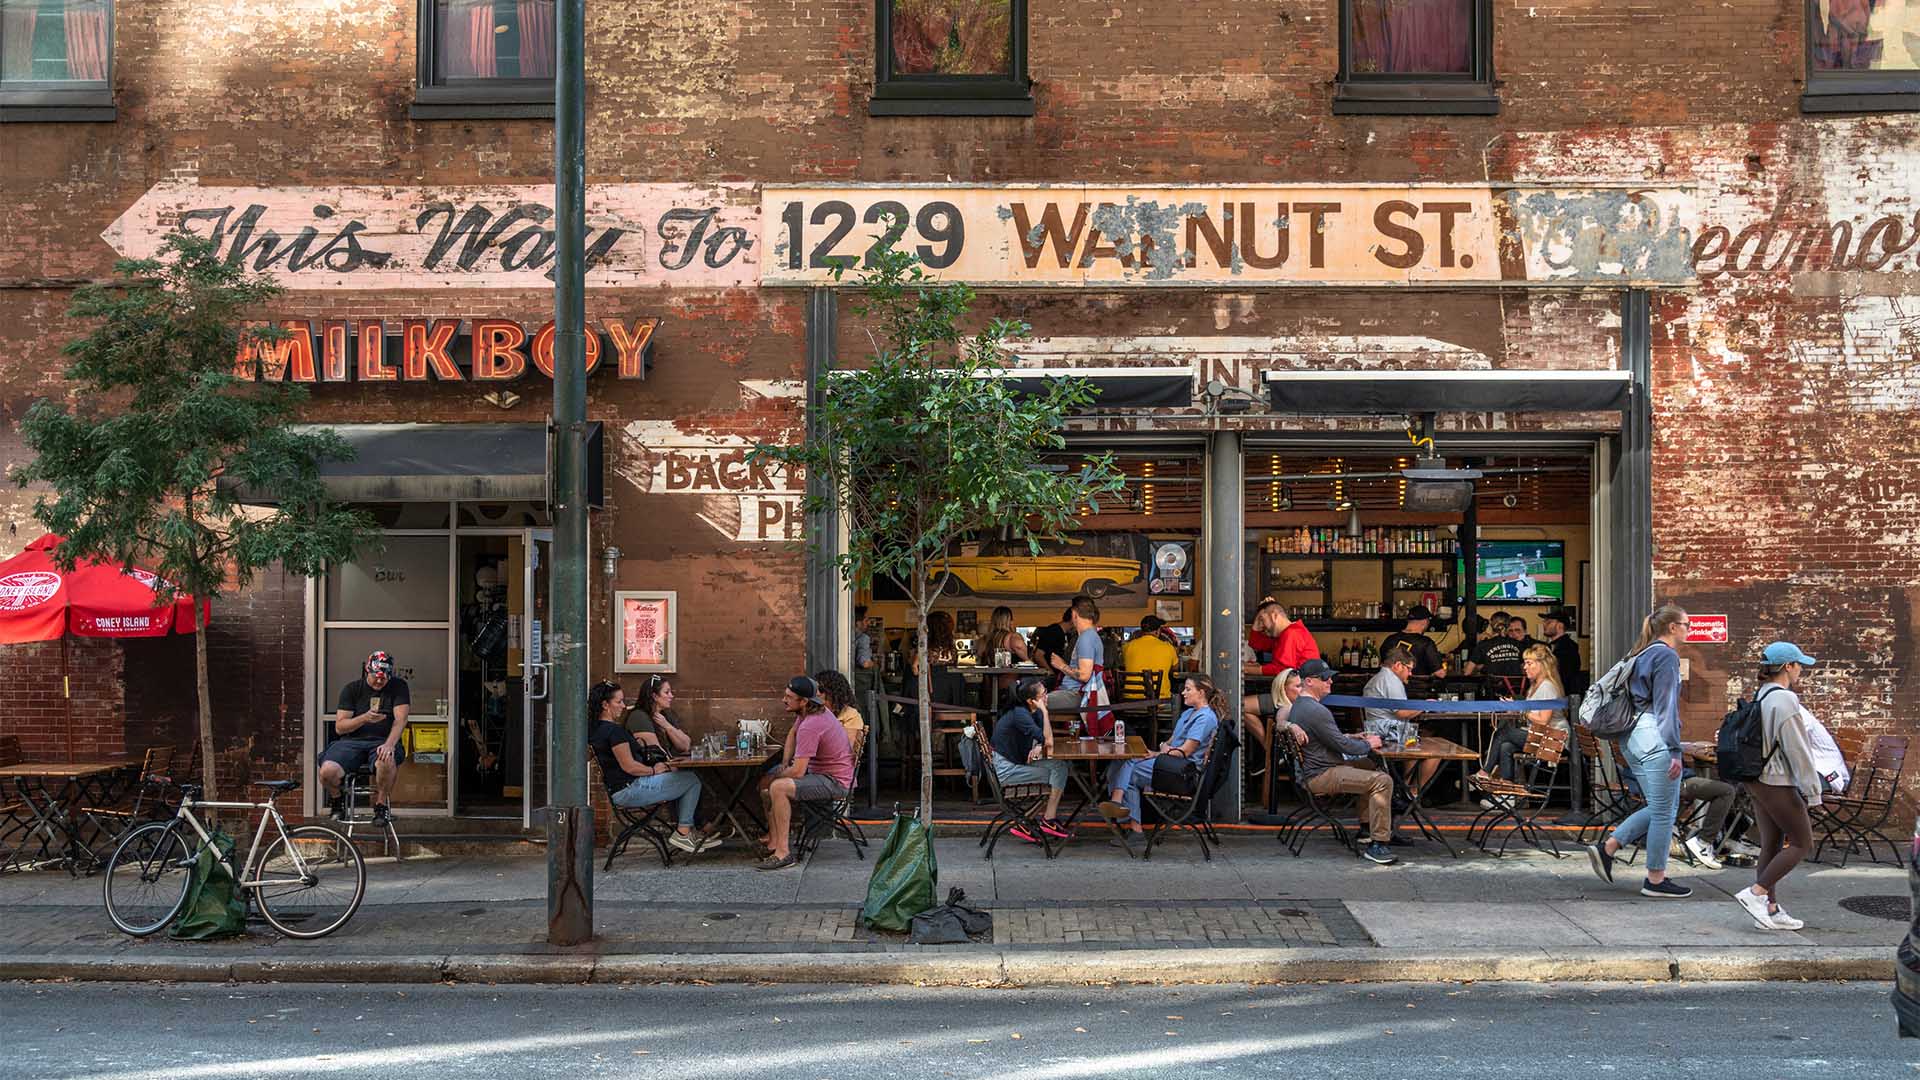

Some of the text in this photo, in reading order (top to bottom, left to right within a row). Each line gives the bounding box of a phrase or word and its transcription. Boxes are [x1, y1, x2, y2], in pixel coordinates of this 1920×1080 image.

[178, 202, 753, 281] This Way To
[780, 200, 965, 269] 1229
[1373, 199, 1474, 269] ST.
[232, 317, 662, 383] MILKBOY
[95, 616, 150, 628] CONEY ISLAND
[1689, 620, 1725, 628] Automatic
